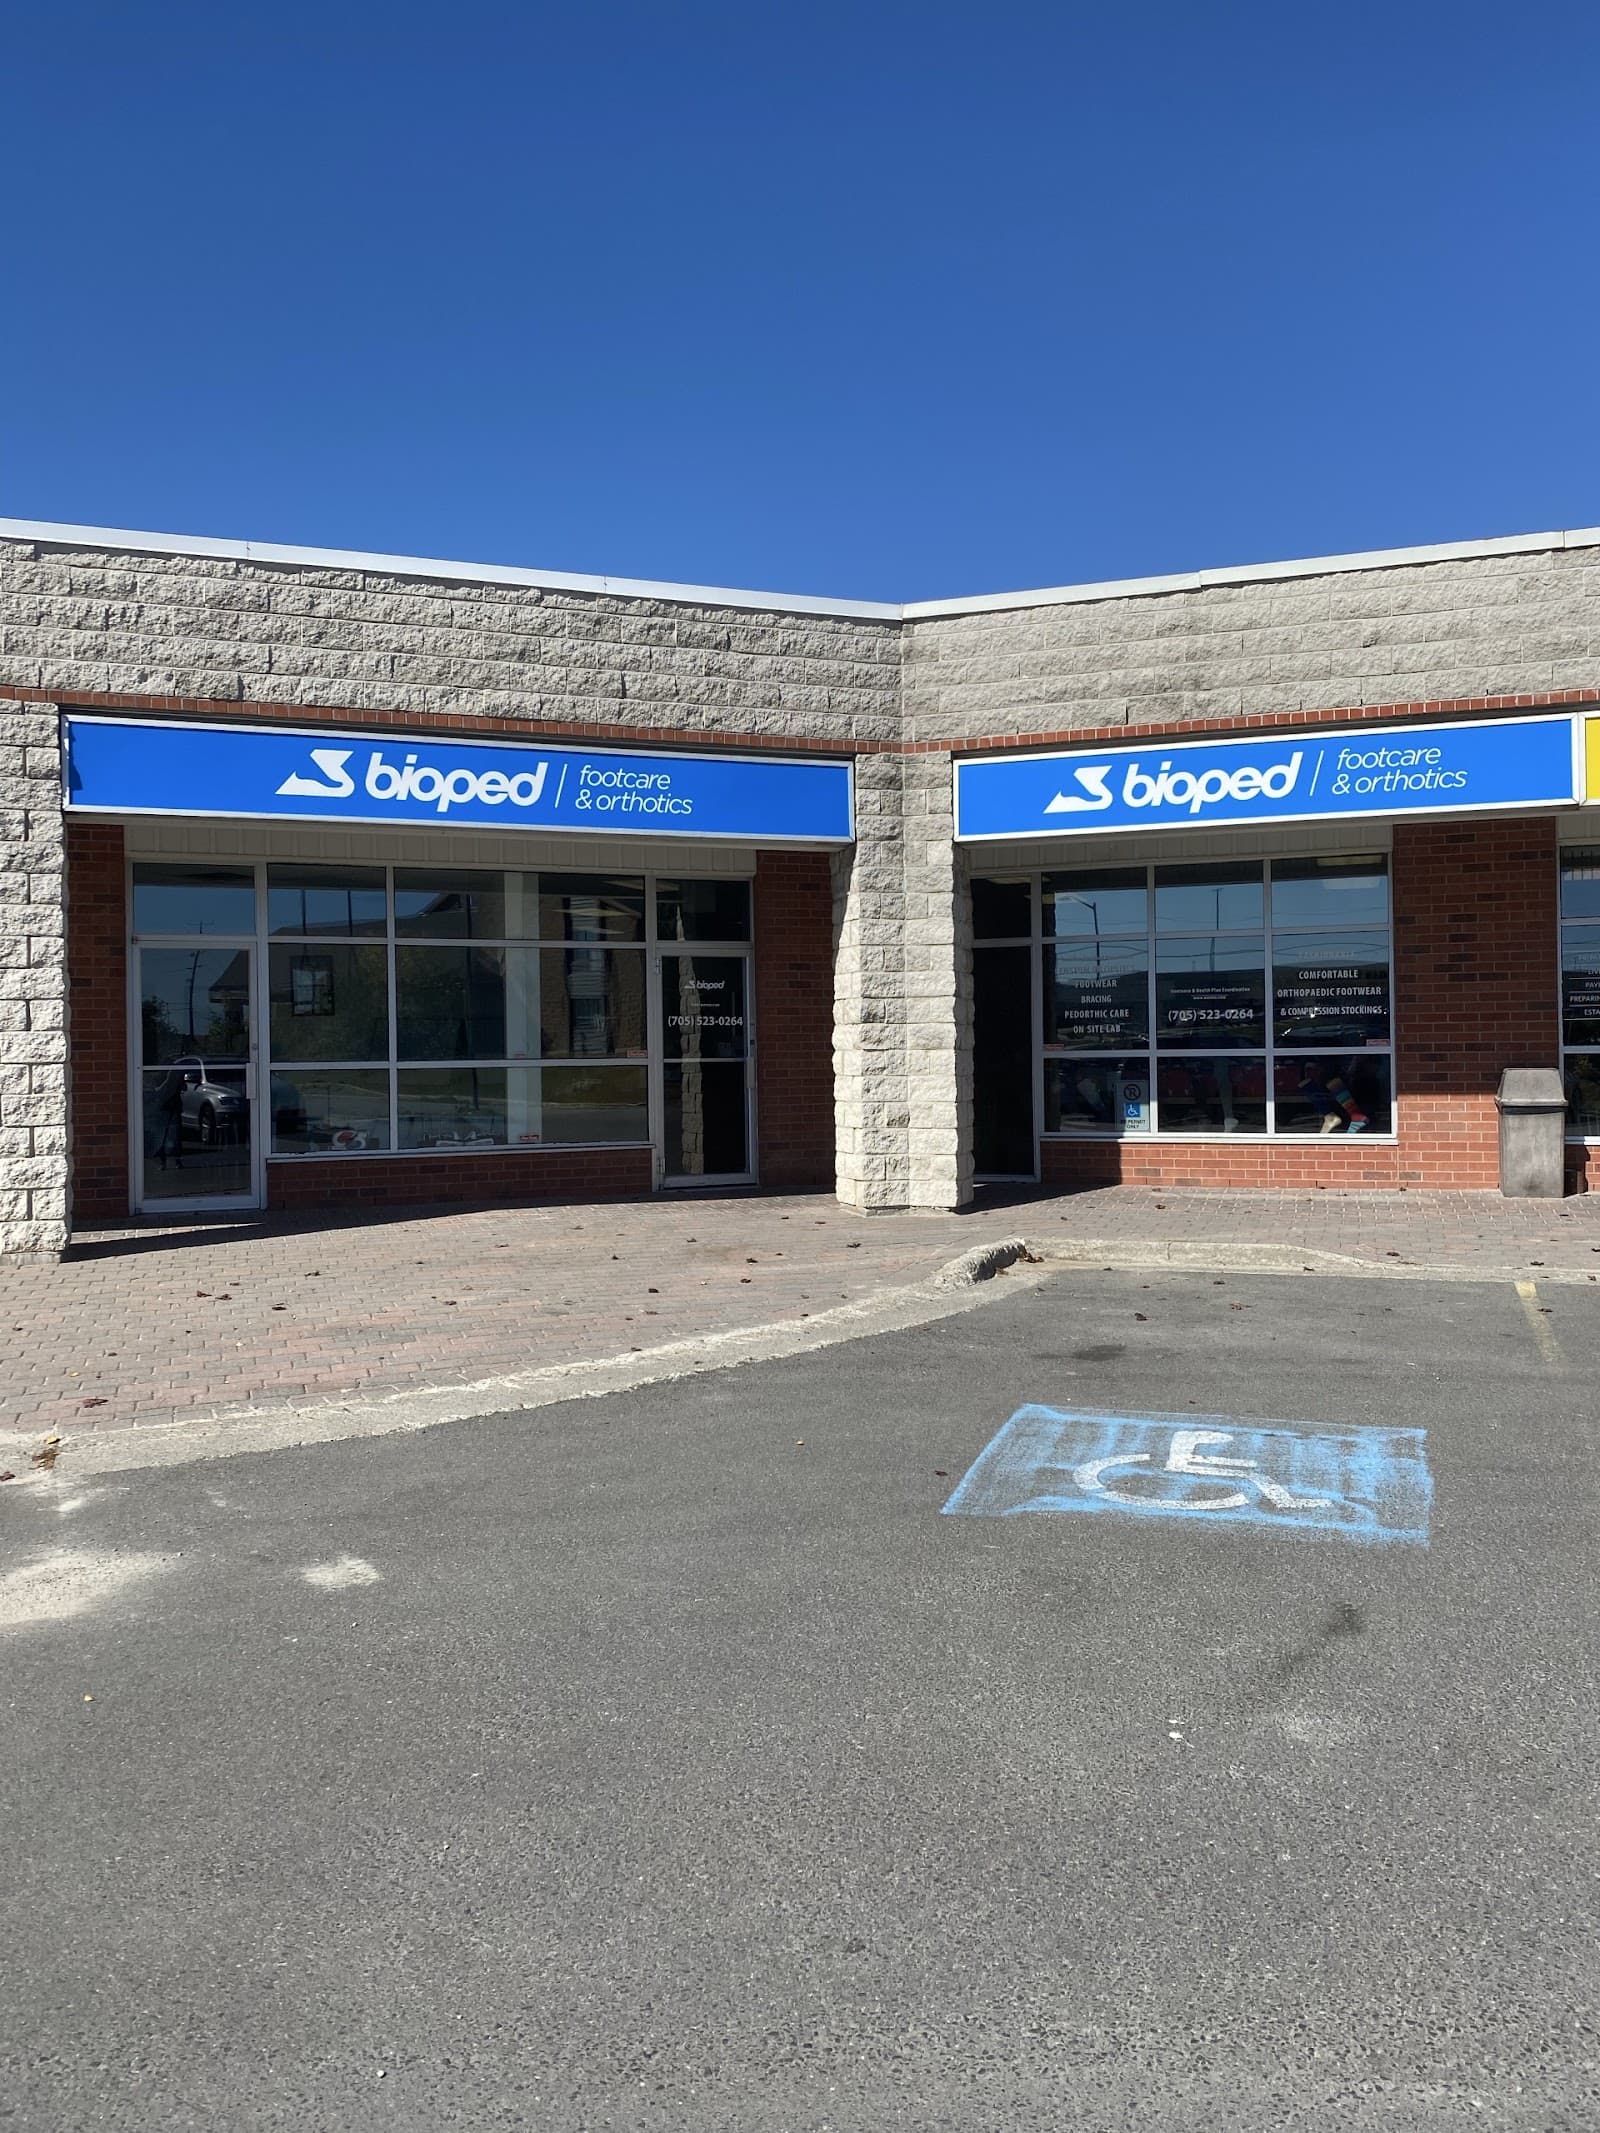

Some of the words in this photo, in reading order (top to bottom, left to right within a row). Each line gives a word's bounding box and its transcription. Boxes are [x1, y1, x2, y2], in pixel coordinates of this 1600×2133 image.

[1336, 747, 1442, 771] footcare
[365, 752, 549, 813] bioped
[580, 764, 671, 790] footcare
[1122, 752, 1304, 814] bioped
[1331, 773, 1351, 795] &
[1354, 766, 1468, 794] orthotics
[575, 788, 592, 810] &
[596, 791, 694, 815] orthotics
[1298, 969, 1359, 980] COMFORTABLE
[1277, 988, 1335, 998] ORTHOPAEDIC
[1336, 986, 1382, 996] FOOTWEAR
[1081, 994, 1112, 1004] BRACING
[1064, 1009, 1108, 1020] PEDORTHIC
[1109, 1008, 1130, 1018] CARE
[1168, 1009, 1197, 1023] (705)
[1199, 1008, 1254, 1020] 523-0264
[1280, 1007, 1287, 1016] &
[1288, 1006, 1340, 1017] COMPRESSION
[1341, 1005, 1383, 1015] STOCKINGS
[668, 1015, 695, 1027] (705)
[696, 1016, 743, 1026] 523-0264
[1073, 1025, 1084, 1034] ON
[1087, 1024, 1105, 1034] SITE
[1106, 1024, 1121, 1033] LAB
